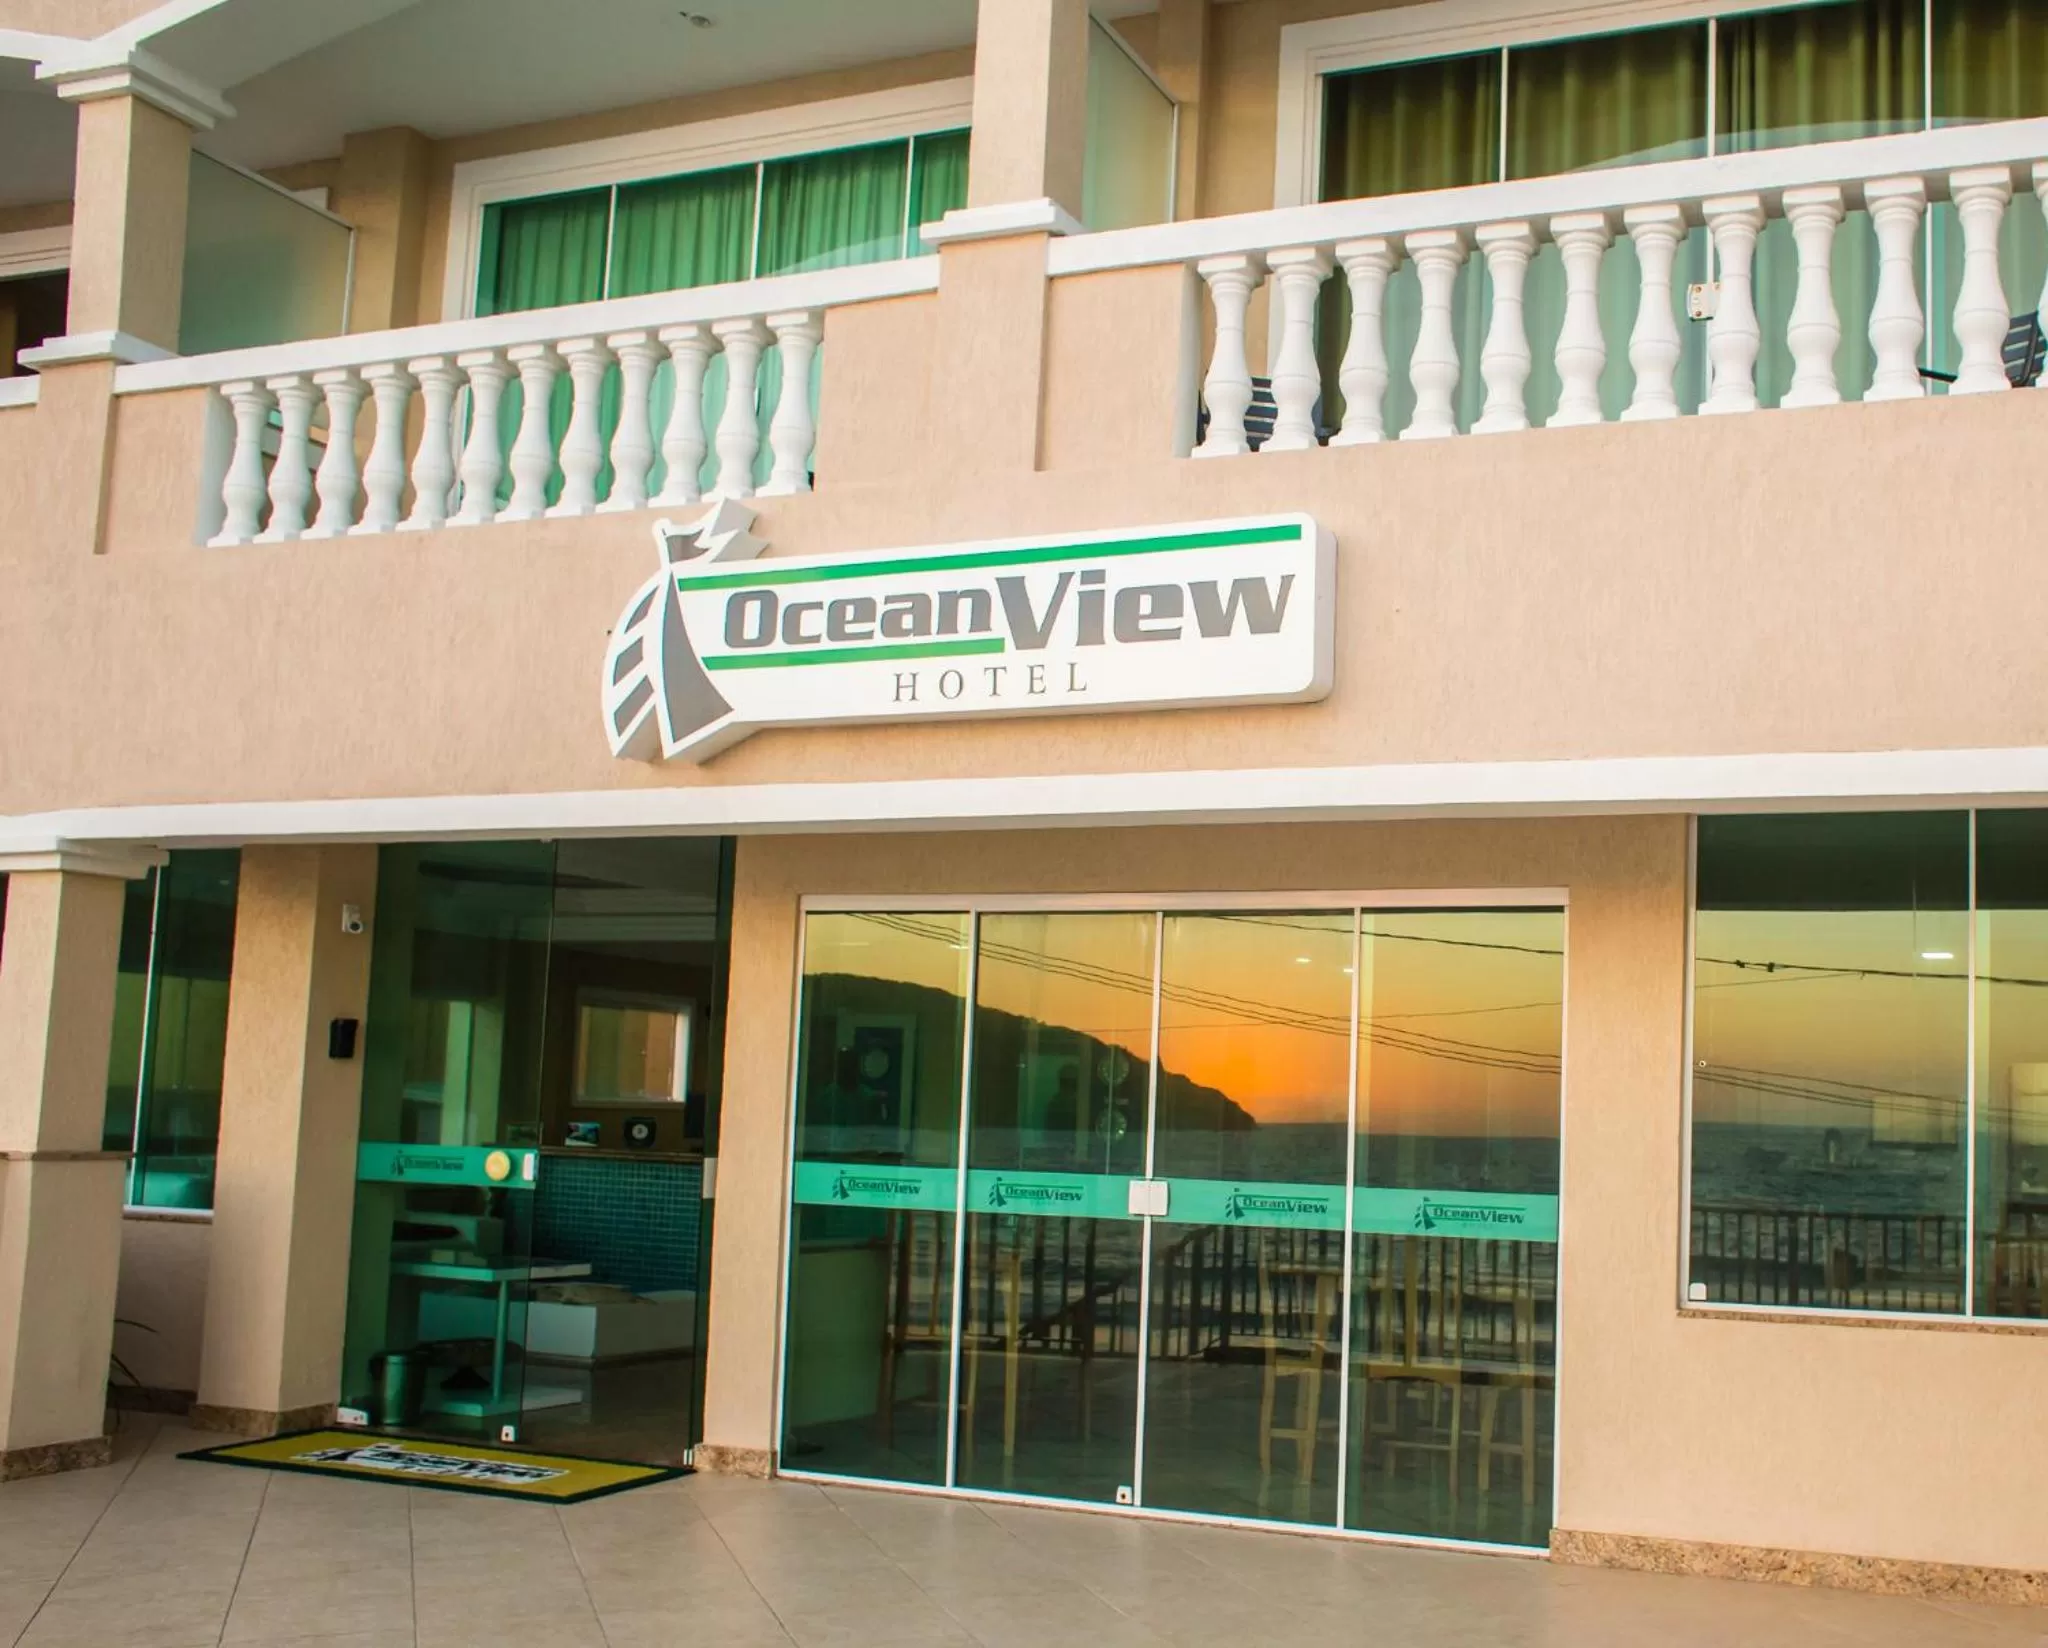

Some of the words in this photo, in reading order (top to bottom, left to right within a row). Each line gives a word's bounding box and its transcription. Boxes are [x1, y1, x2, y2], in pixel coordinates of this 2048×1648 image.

[724, 570, 1296, 650] OceanView
[892, 662, 1088, 702] HOTEL
[1243, 1196, 1328, 1214] OceanView
[1433, 1207, 1525, 1224] OceanView
